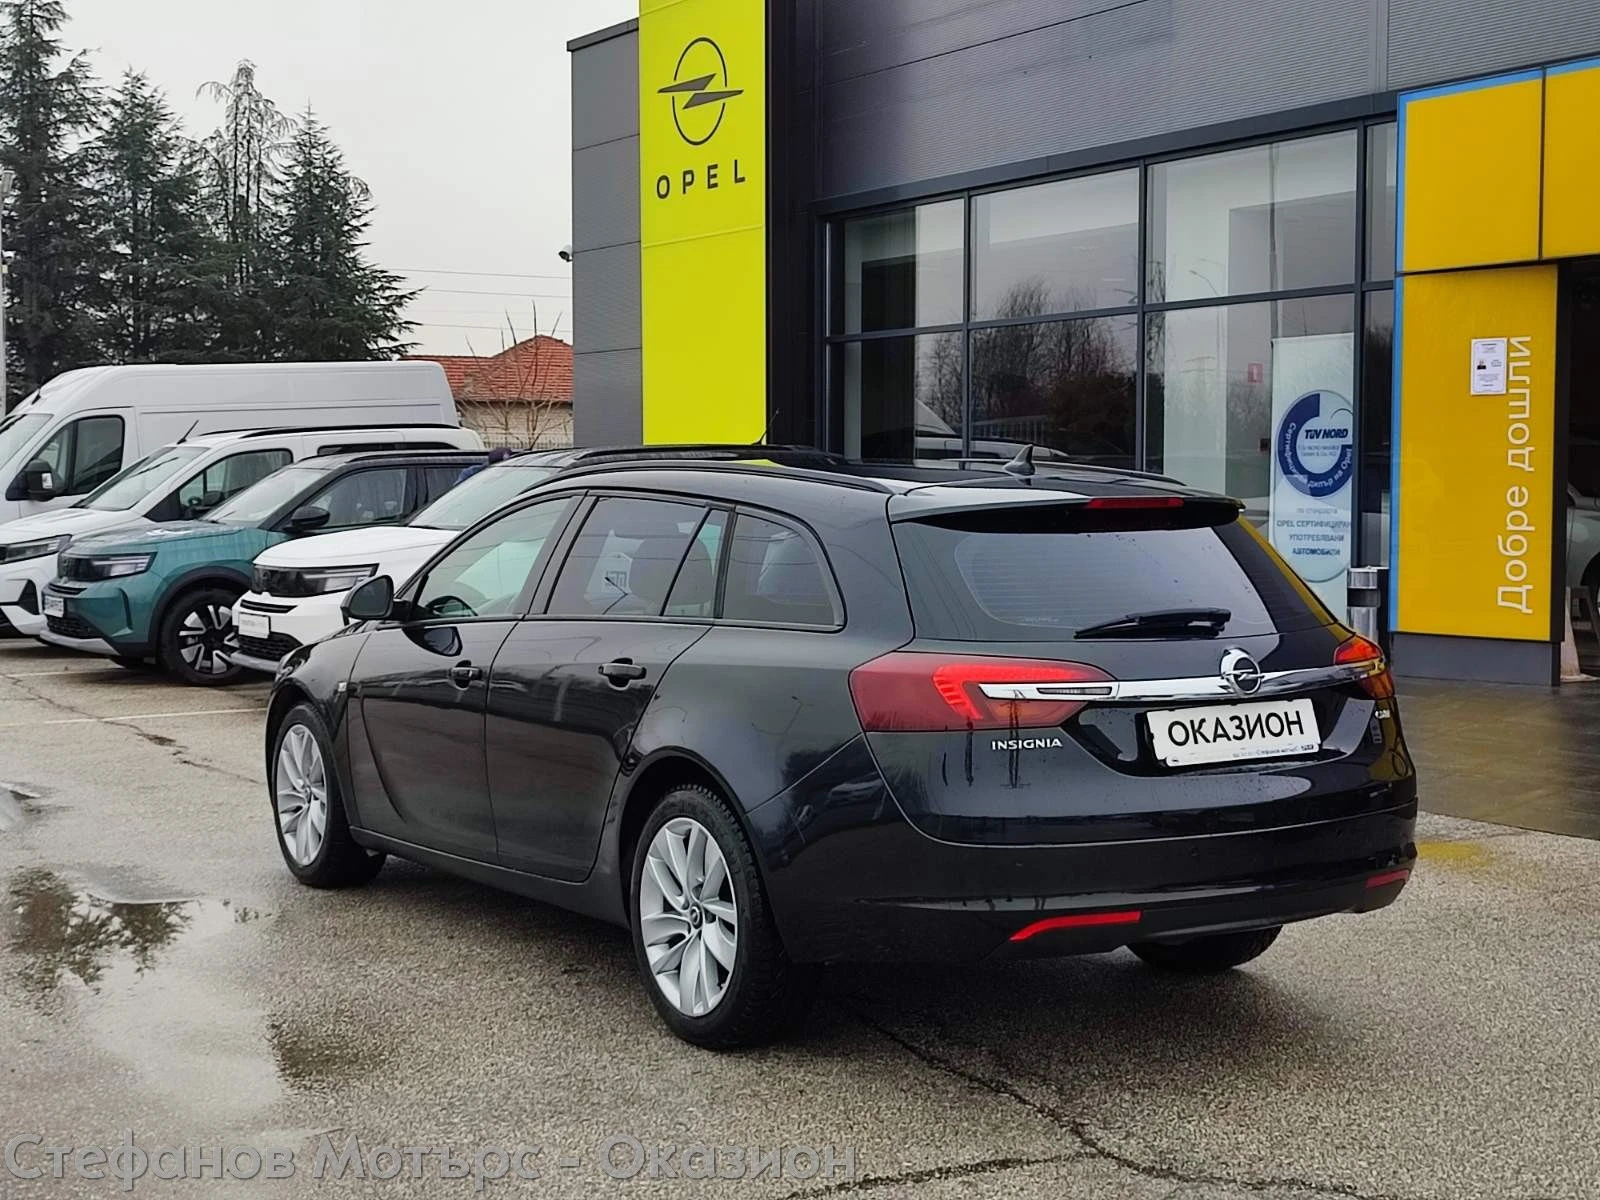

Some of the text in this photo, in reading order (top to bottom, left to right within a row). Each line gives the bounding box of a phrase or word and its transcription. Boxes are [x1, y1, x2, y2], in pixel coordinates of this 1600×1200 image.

[656, 159, 746, 200] OPEL
[1304, 428, 1349, 440] TÜV NORD
[1497, 336, 1536, 614] Добре дошли
[1276, 520, 1295, 528] OPEL
[1168, 710, 1304, 747] ОКАЗИОН
[991, 738, 1064, 751] INSIGNIA
